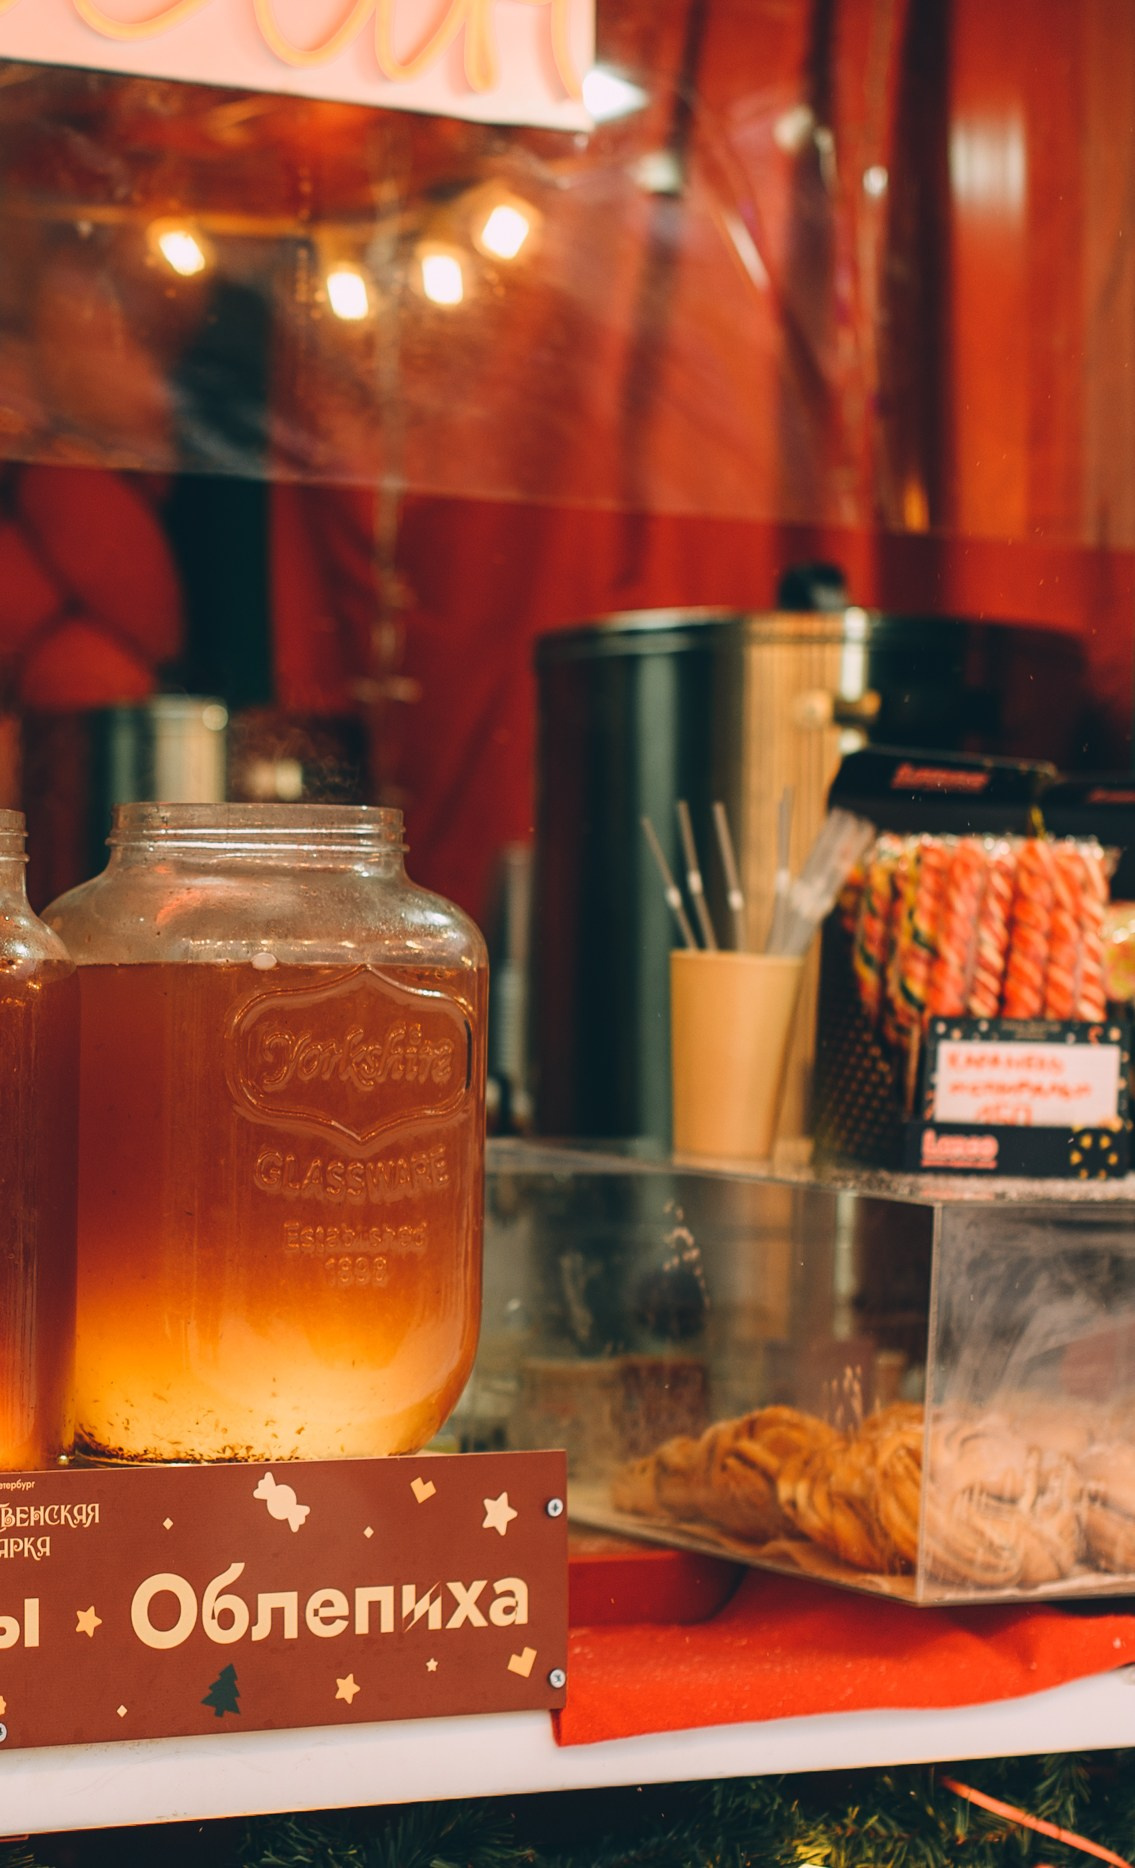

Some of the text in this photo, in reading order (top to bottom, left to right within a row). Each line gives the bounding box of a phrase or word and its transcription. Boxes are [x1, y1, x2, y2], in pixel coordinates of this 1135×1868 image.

[262, 1022, 456, 1091] Yorkshire
[253, 1143, 451, 1204] GLASSWARE
[130, 1561, 530, 1650] Облепиха
